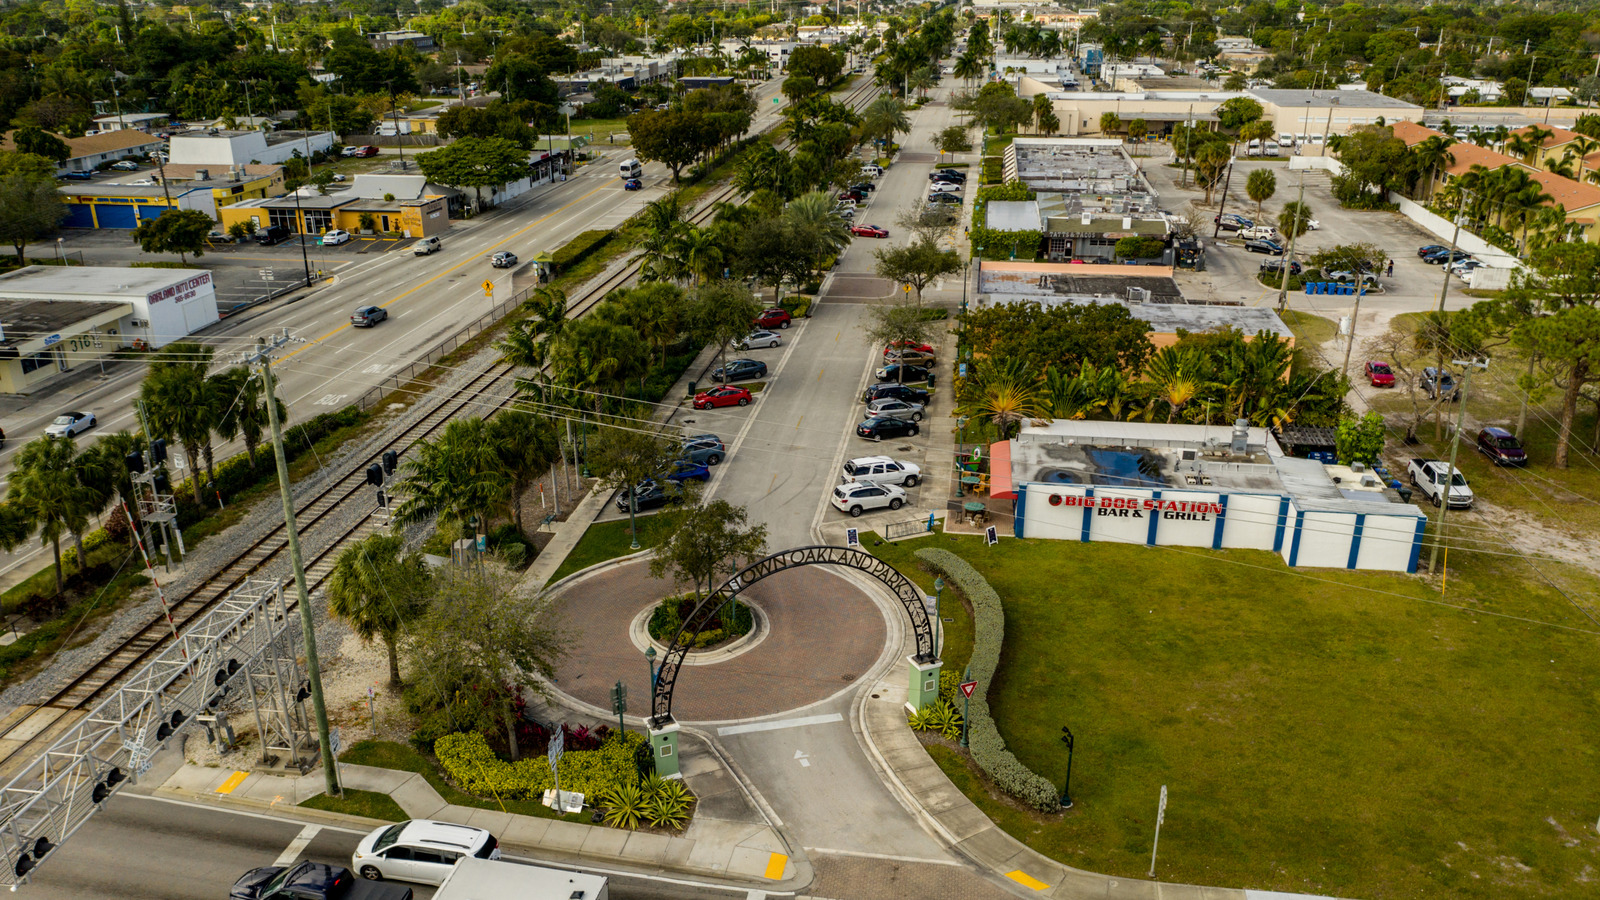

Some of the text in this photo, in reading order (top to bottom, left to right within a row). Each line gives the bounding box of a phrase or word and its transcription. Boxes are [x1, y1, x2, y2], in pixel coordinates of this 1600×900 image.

[148, 273, 211, 305] OAKLAND AUTO CENTER
[313, 393, 348, 406] BUS
[1065, 495, 1223, 515] BIG DOG STATION
[1097, 507, 1210, 522] BAR & GRILL
[685, 546, 908, 633] DOWNTOWN OAKLAND PARK
